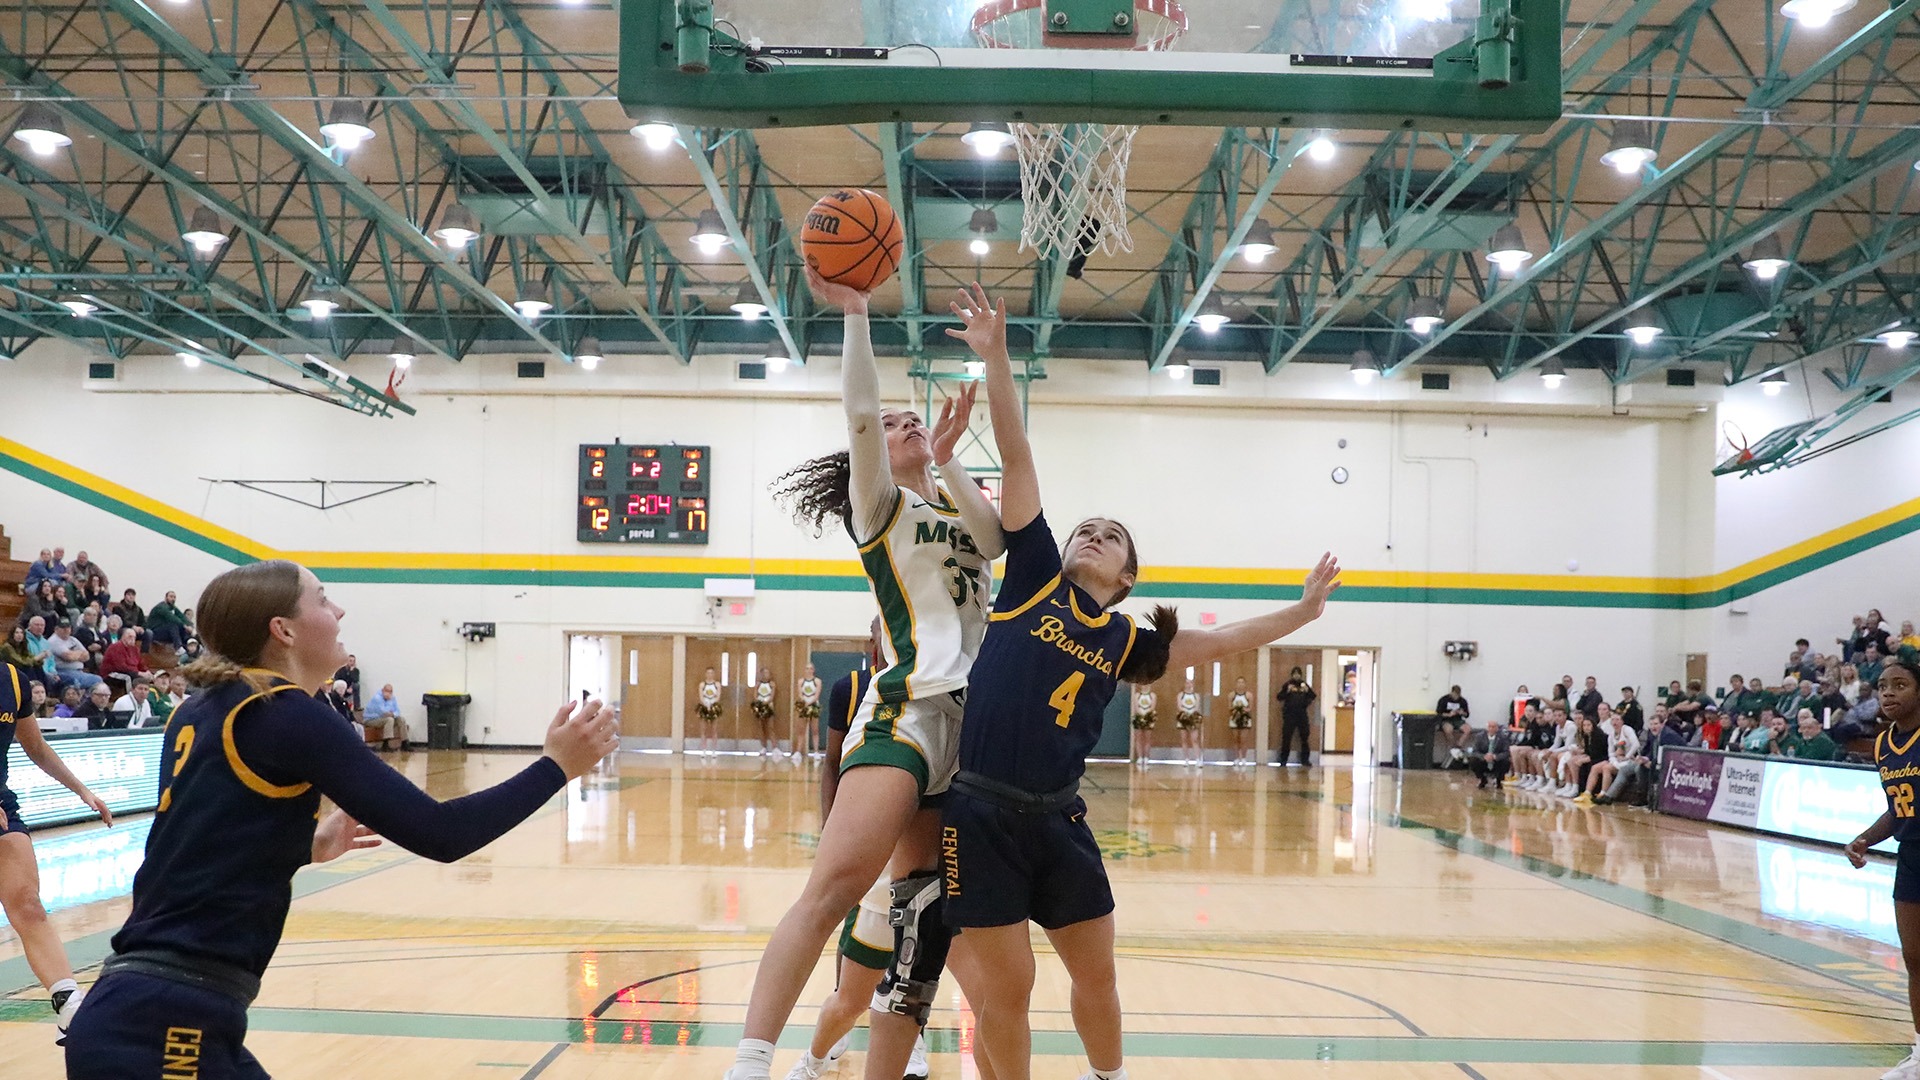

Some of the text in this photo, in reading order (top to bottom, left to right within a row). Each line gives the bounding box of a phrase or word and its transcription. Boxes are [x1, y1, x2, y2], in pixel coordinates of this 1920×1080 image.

[592, 461, 604, 477] 2
[687, 462, 699, 479] 2
[628, 494, 672, 515] 2:04
[591, 508, 610, 530] 12
[687, 510, 706, 531] 17
[629, 528, 656, 539] period
[1030, 615, 1113, 679] Broncho
[1048, 670, 1086, 729] 4
[1725, 766, 1761, 783] Ultra-Fast
[1727, 782, 1757, 796] Internet
[1886, 782, 1915, 818] 22
[942, 826, 961, 899] CENTRAL
